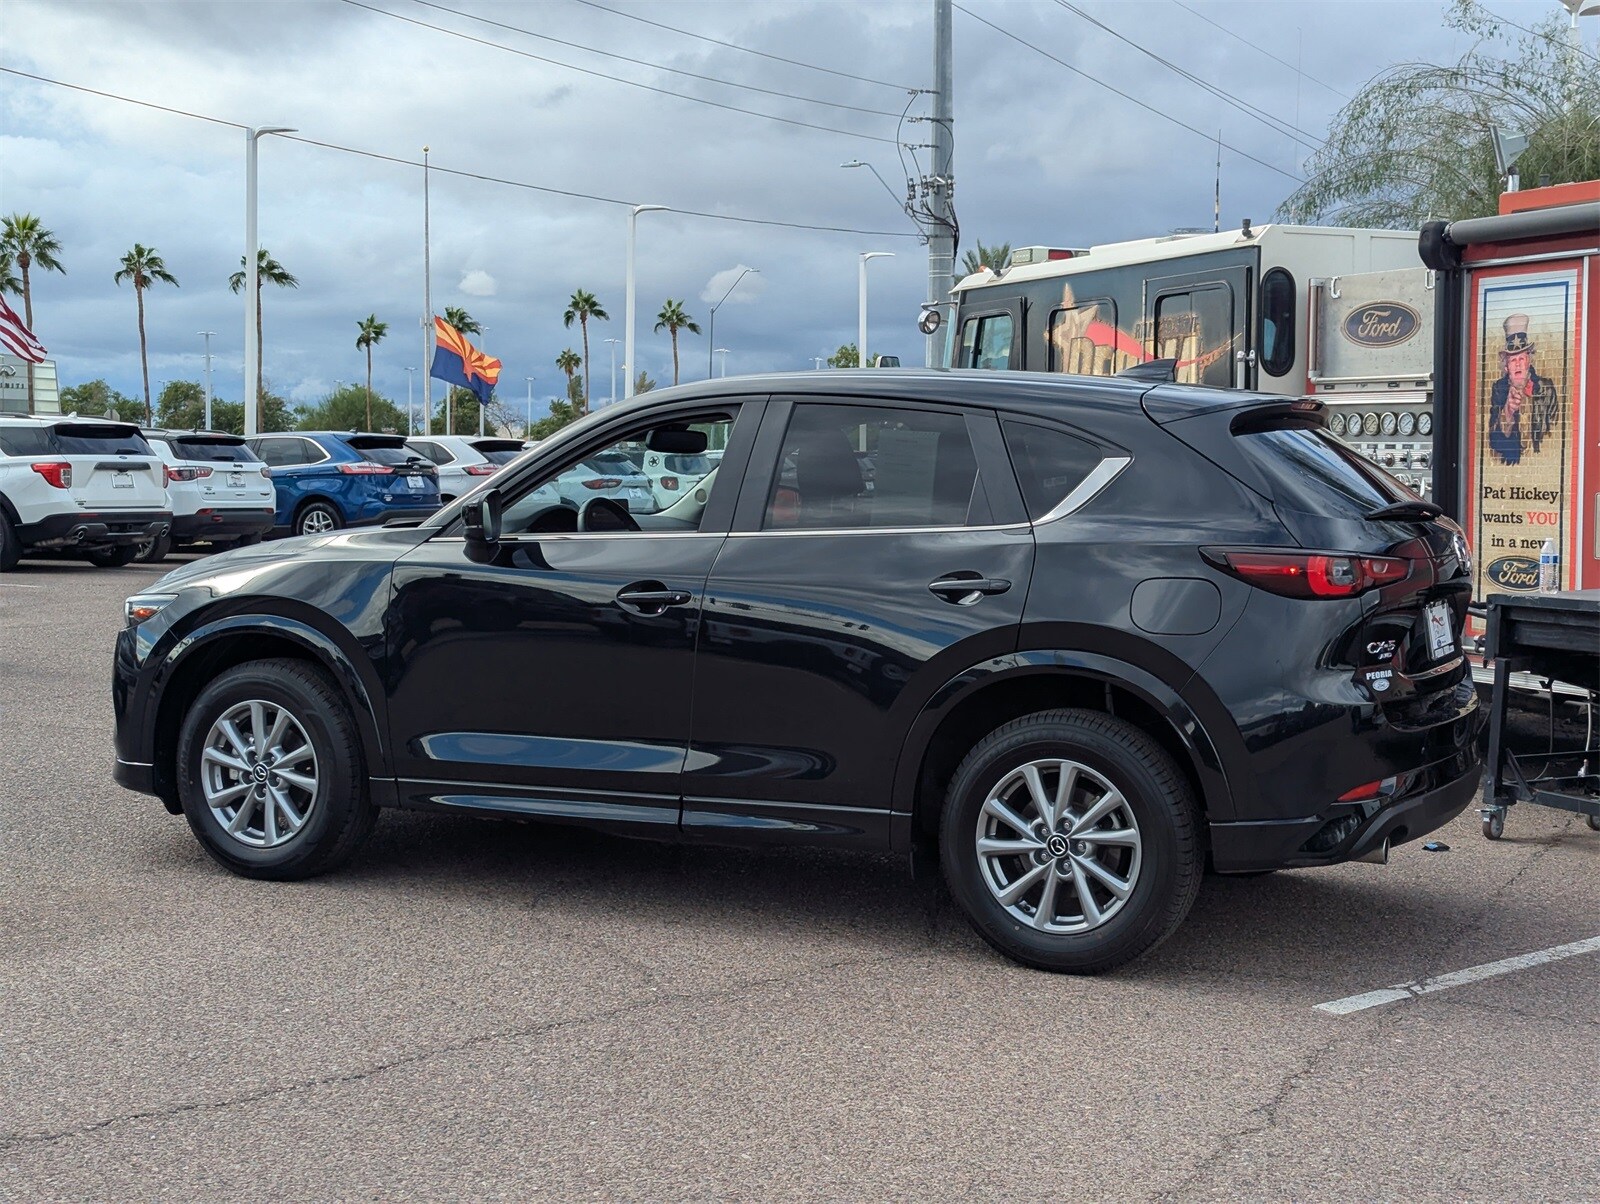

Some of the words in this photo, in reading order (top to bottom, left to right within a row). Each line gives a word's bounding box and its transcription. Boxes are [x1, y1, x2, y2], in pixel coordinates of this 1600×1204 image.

[1358, 310, 1402, 338] Ford
[1483, 486, 1506, 499] Pat
[1509, 486, 1559, 504] Hickey
[1483, 511, 1523, 524] wants
[1526, 511, 1559, 525] YOU
[1491, 534, 1505, 548] in
[1508, 538, 1517, 548] a
[1498, 560, 1540, 586] Ford
[1366, 640, 1396, 655] CX-5
[1365, 669, 1393, 681] PEORIA
